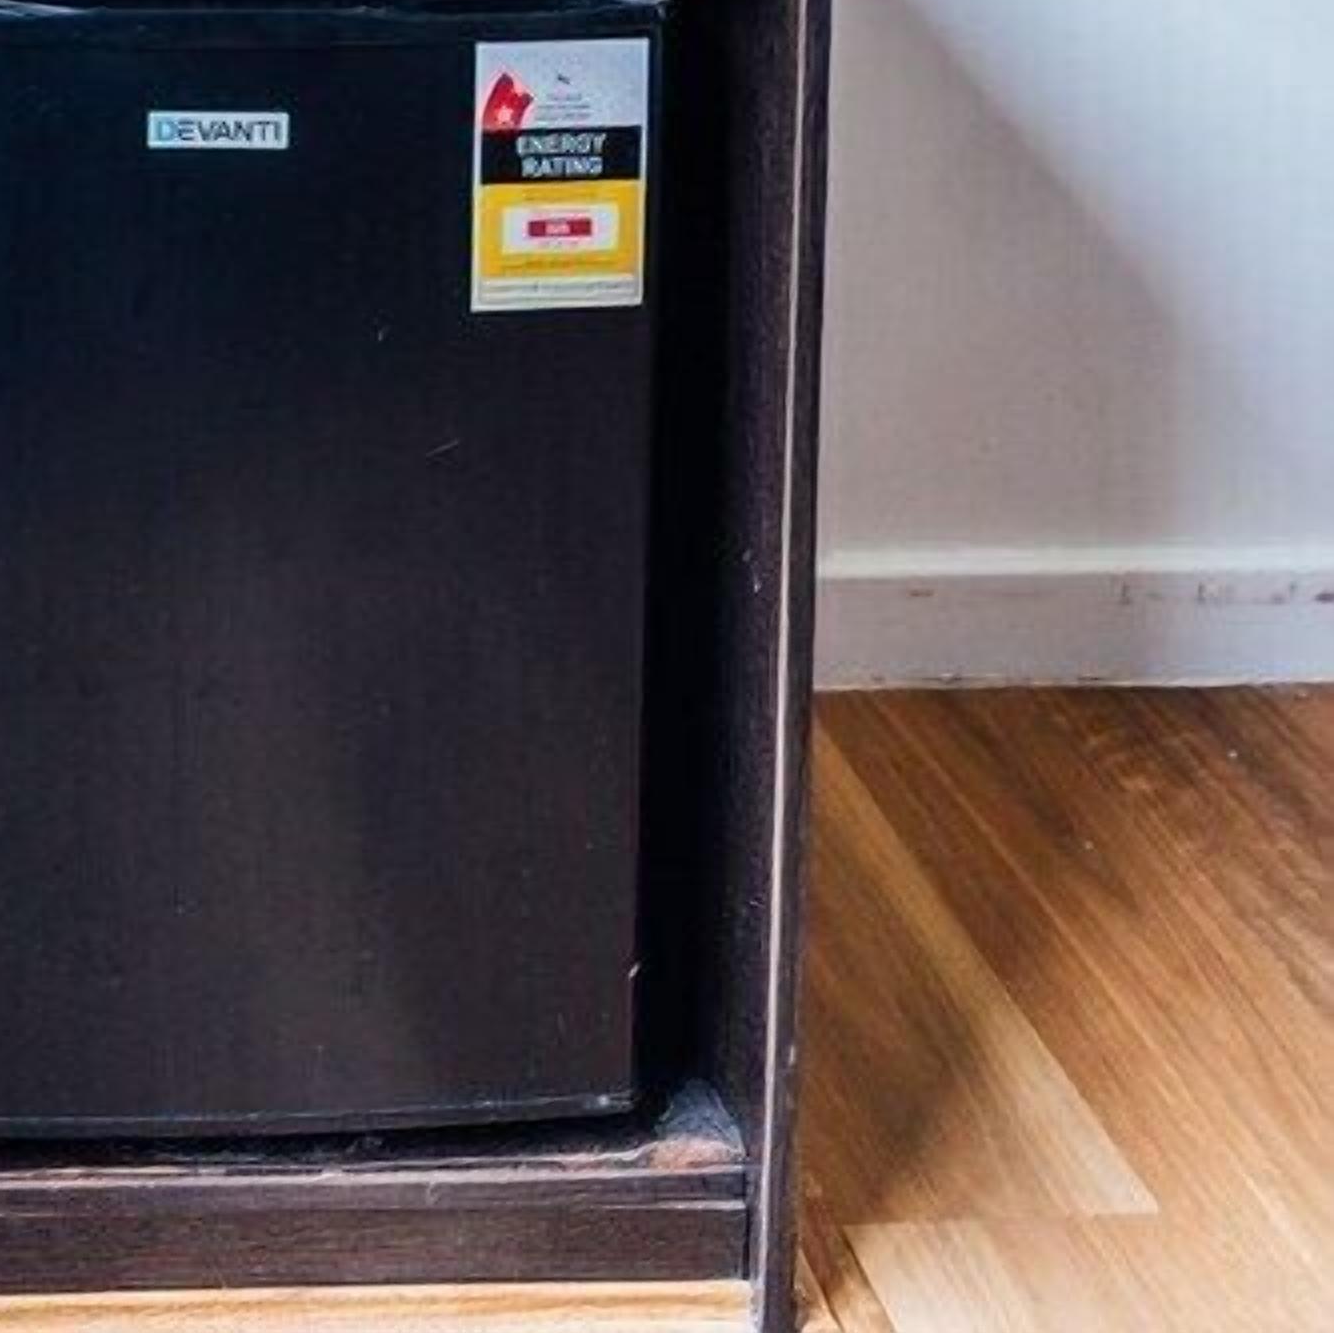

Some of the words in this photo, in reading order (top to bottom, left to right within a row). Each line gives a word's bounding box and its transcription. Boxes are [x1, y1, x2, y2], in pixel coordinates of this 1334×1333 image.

[156, 120, 282, 141] DEVANTI
[517, 133, 606, 155] ENERGY
[522, 156, 602, 177] RATING
